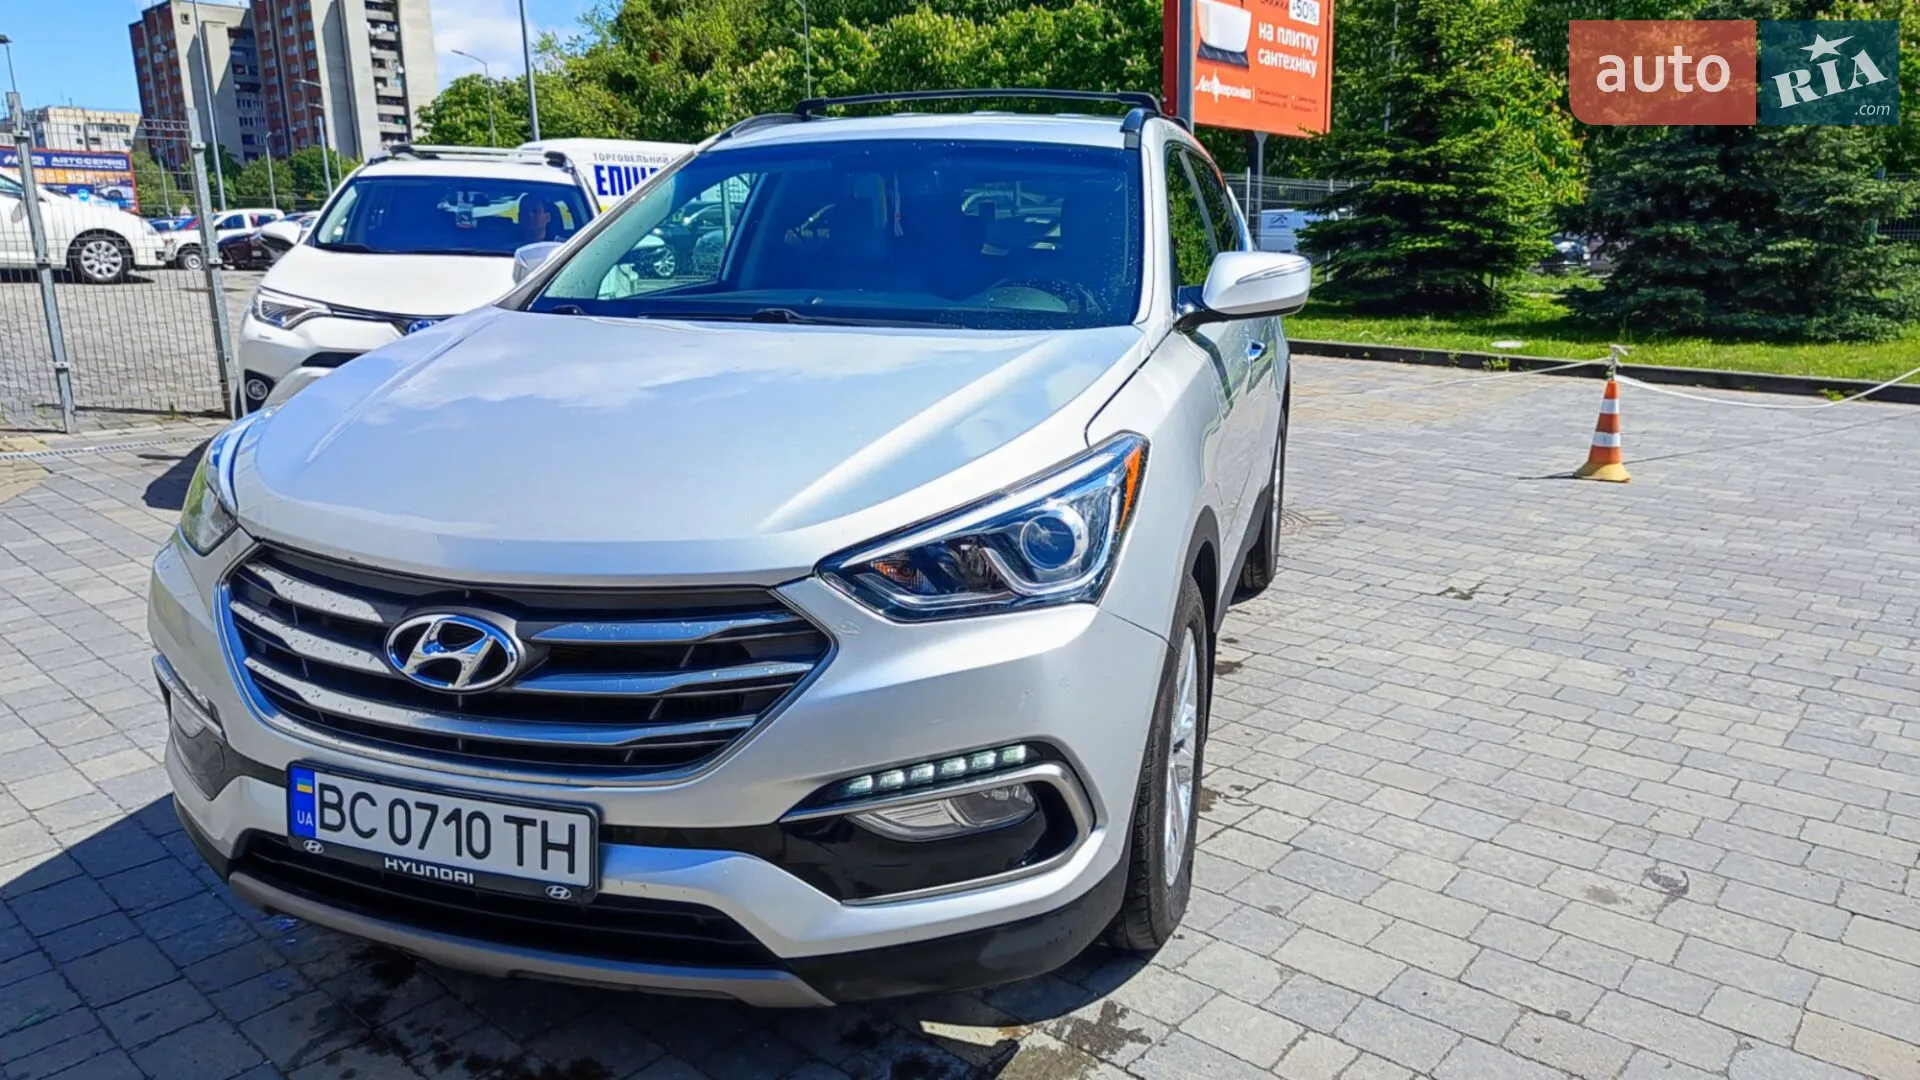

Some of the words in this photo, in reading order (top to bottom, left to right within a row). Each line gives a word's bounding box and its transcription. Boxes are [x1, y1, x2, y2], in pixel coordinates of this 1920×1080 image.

[1258, 21, 1274, 42] на
[1277, 26, 1320, 57] плитку
[1258, 48, 1318, 79] сантехніку
[296, 809, 314, 828] UA
[318, 783, 378, 840] BC
[388, 797, 491, 861] 0710
[504, 815, 576, 875] TH
[384, 857, 475, 886] HYUNDAI
